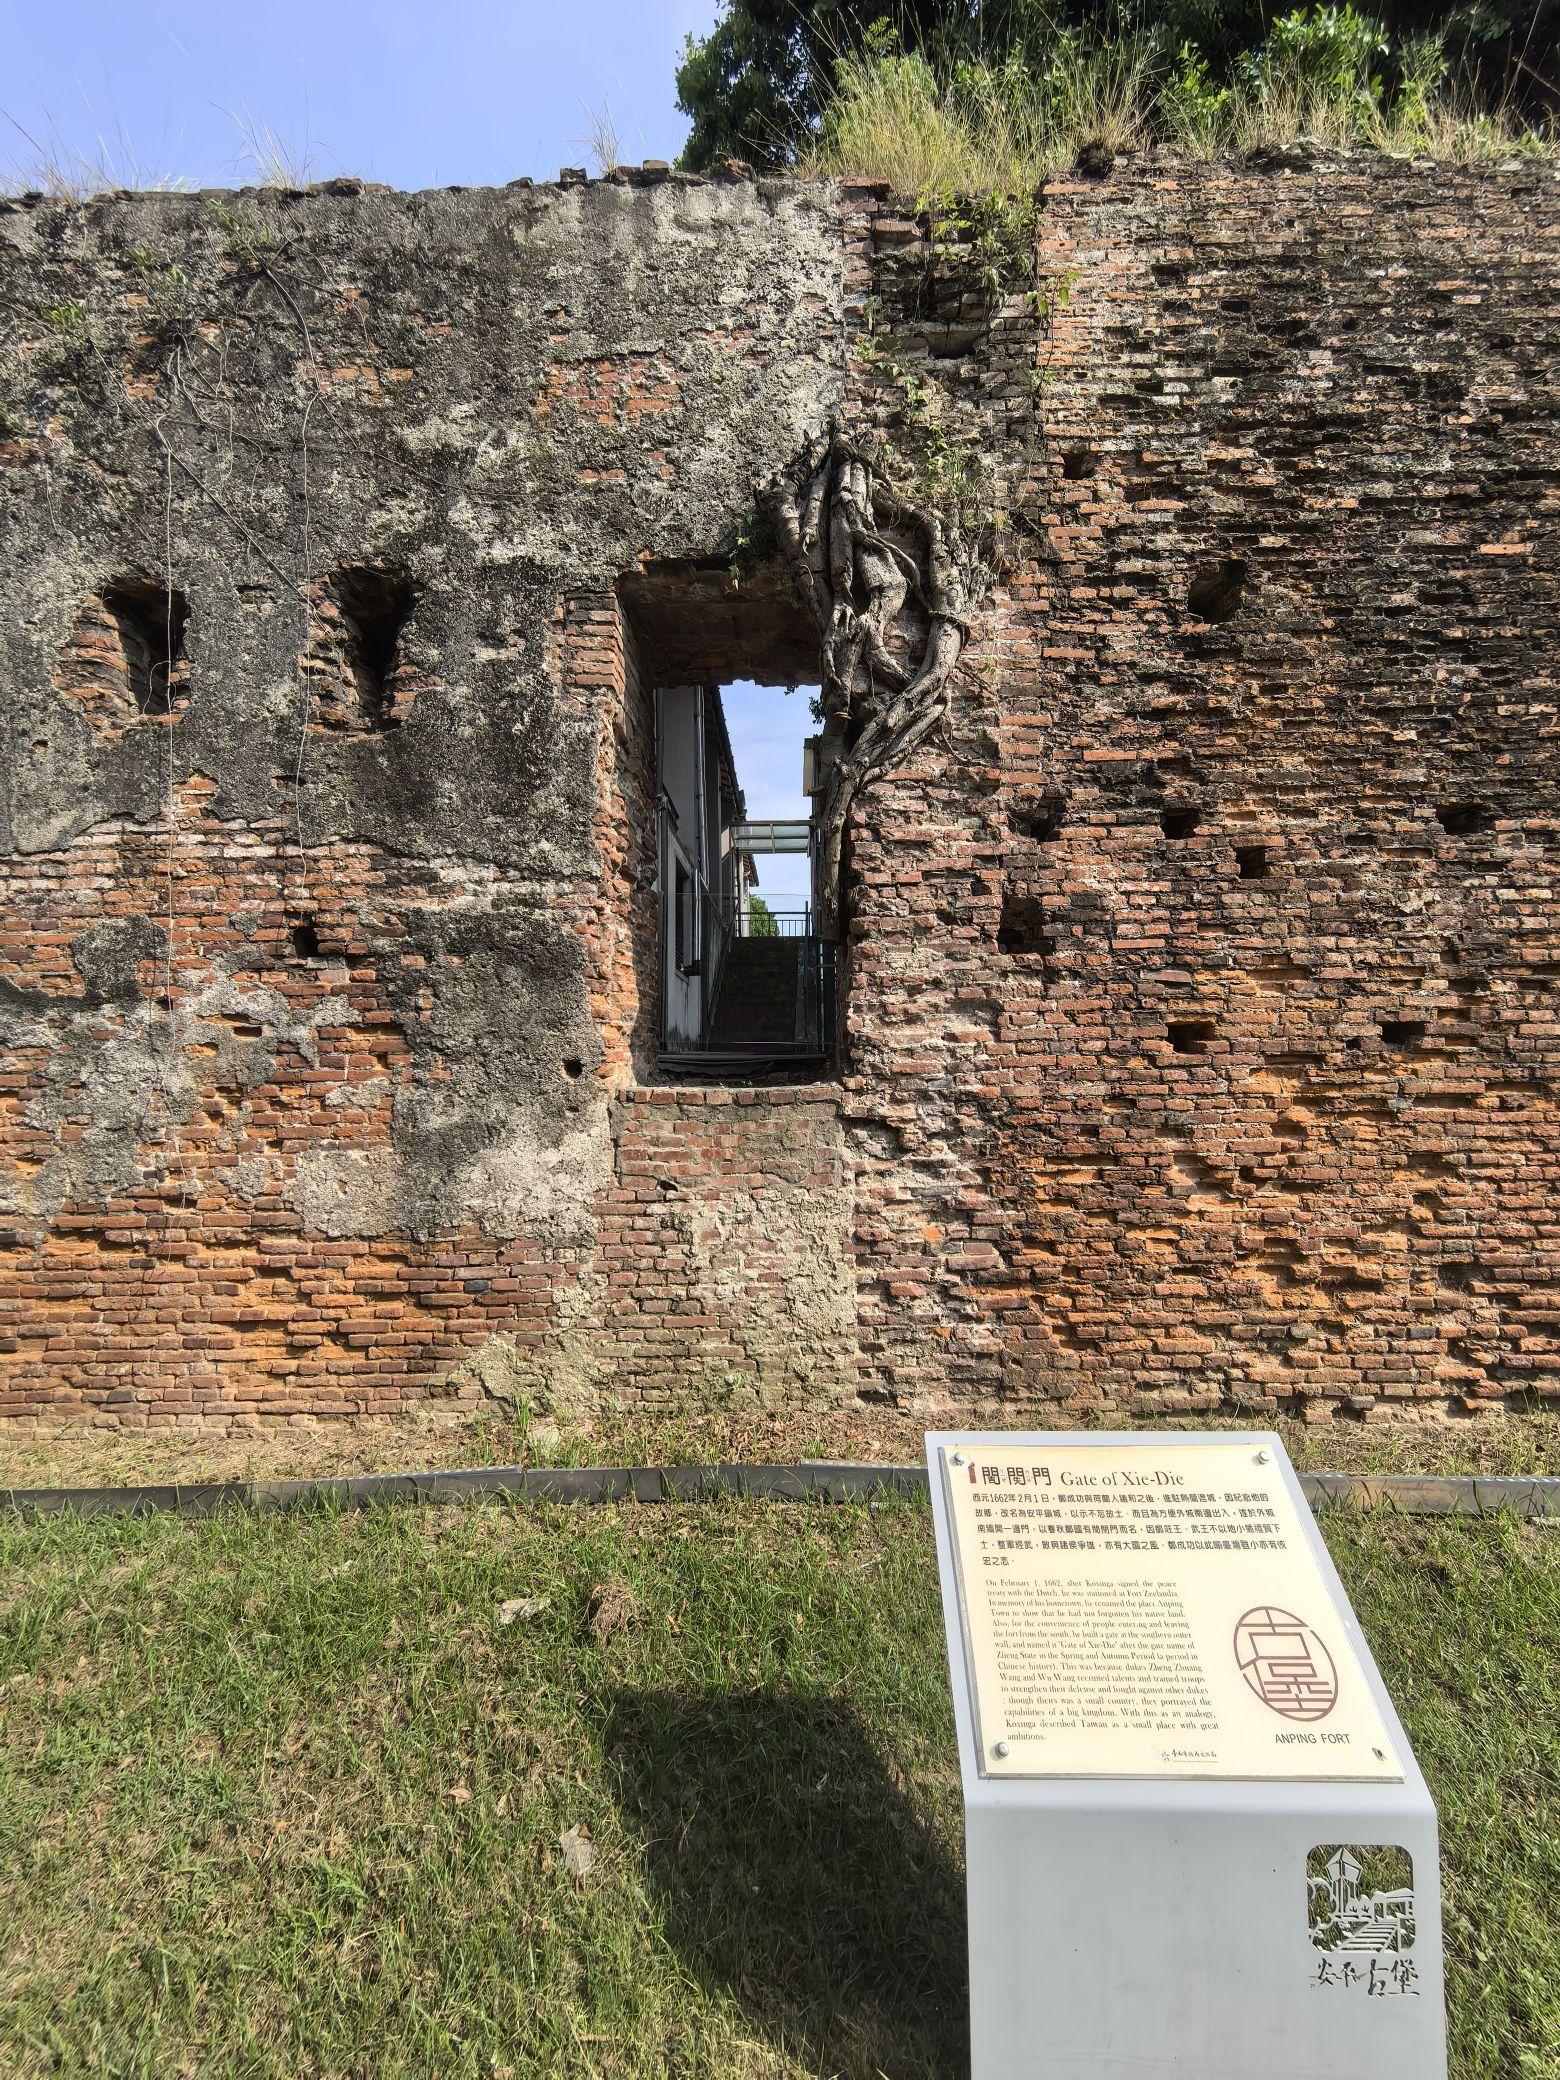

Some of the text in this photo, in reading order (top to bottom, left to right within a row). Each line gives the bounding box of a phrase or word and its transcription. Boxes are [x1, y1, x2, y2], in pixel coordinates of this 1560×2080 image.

[1061, 1471, 1185, 1486] Gate of Xie-Die
[1000, 1579, 1029, 1588] February
[1086, 1580, 1113, 1588] Koxinga
[1118, 1580, 1138, 1588] signed
[988, 1590, 1005, 1598] treaty
[1138, 1600, 1155, 1608] place
[1158, 1600, 1183, 1609] Anping
[1098, 1610, 1129, 1619] forgotten
[1092, 1620, 1115, 1629] people
[1118, 1621, 1147, 1629] entering
[1164, 1620, 1189, 1629] leaving
[1105, 1631, 1118, 1640] gate
[1151, 1642, 1164, 1650] gate
[996, 1651, 1018, 1661] Zheng
[1061, 1652, 1084, 1661] Spring
[1166, 1652, 1189, 1661] period
[1149, 1663, 1172, 1672] Zheng
[1175, 1663, 1202, 1673] Zhuang
[1000, 1673, 1021, 1683] Wang
[1054, 1674, 1075, 1683] Wang
[1182, 1675, 1205, 1684] troops
[1011, 1685, 1047, 1694] strengthen
[1113, 1685, 1136, 1695] fought
[1139, 1686, 1162, 1695] against
[1008, 1696, 1033, 1706] though
[1142, 1697, 1156, 1707] they
[1161, 1697, 1196, 1707] portrayed
[1005, 1708, 1044, 1718] capabilities
[1067, 1708, 1078, 1718] big
[1121, 1708, 1140, 1716] With
[1144, 1708, 1157, 1716] this
[1006, 1720, 1035, 1730] Koxinga
[1040, 1720, 1076, 1728] described
[1080, 1720, 1107, 1728] Taiwan
[1132, 1720, 1152, 1728] small
[1157, 1720, 1175, 1730] place
[1180, 1720, 1196, 1729] with
[1200, 1721, 1219, 1731] great
[1275, 1733, 1350, 1744] ANPING FORT
[1308, 1957, 1421, 1998] 安平古堡
